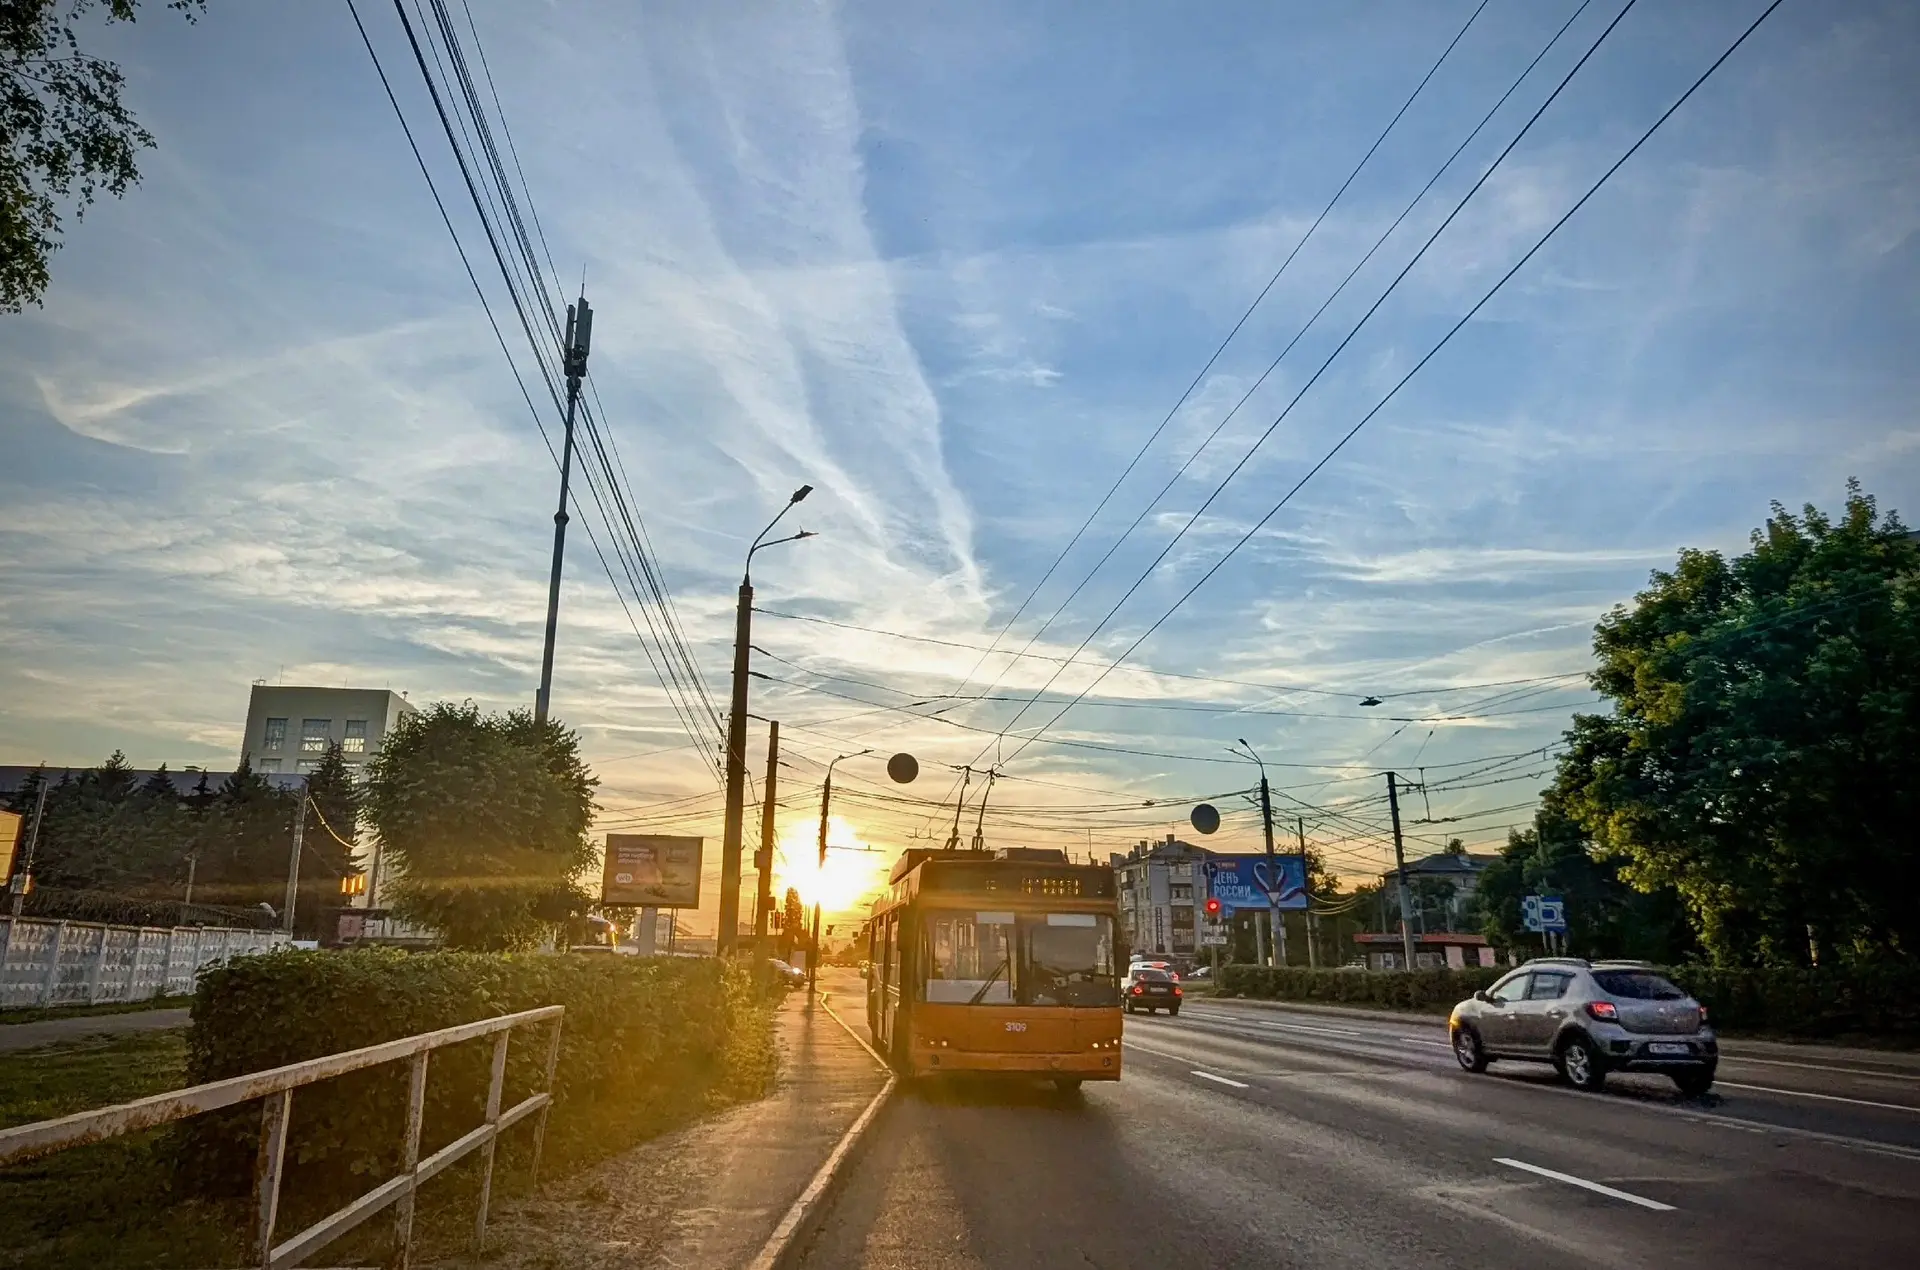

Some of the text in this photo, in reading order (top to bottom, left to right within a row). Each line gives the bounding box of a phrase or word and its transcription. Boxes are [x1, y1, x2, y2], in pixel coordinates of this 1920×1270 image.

[617, 873, 631, 882] wb
[1213, 871, 1239, 885] ДЕНЬ
[1213, 885, 1251, 897] РОССИИ
